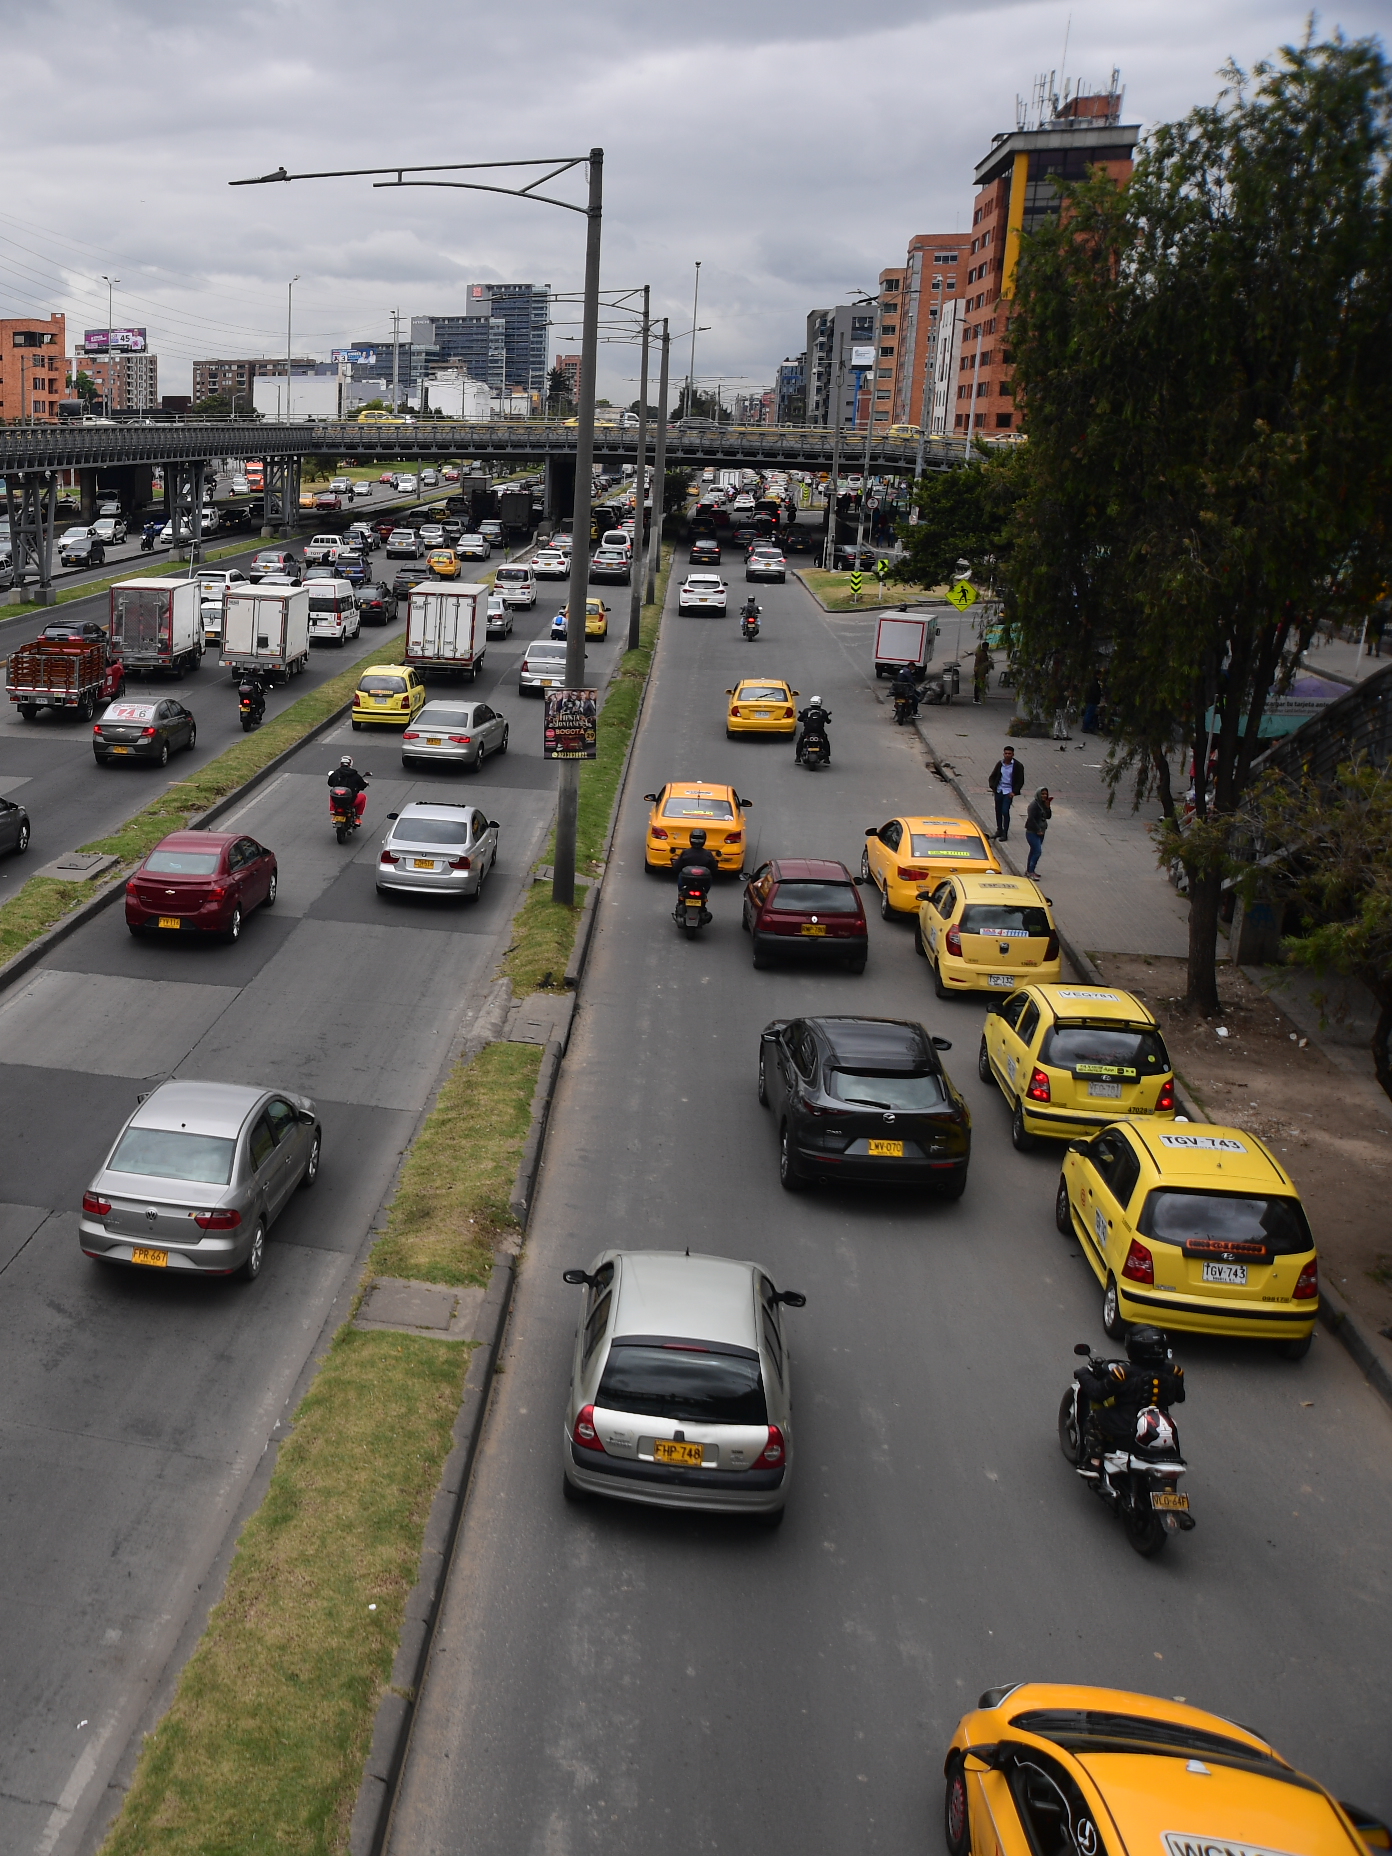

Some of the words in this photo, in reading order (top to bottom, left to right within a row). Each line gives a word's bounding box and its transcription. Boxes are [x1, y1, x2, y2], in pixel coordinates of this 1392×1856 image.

[120, 334, 130, 342] 45
[1162, 1136, 1241, 1149] TGV-743
[1205, 1263, 1246, 1279] TGV-743
